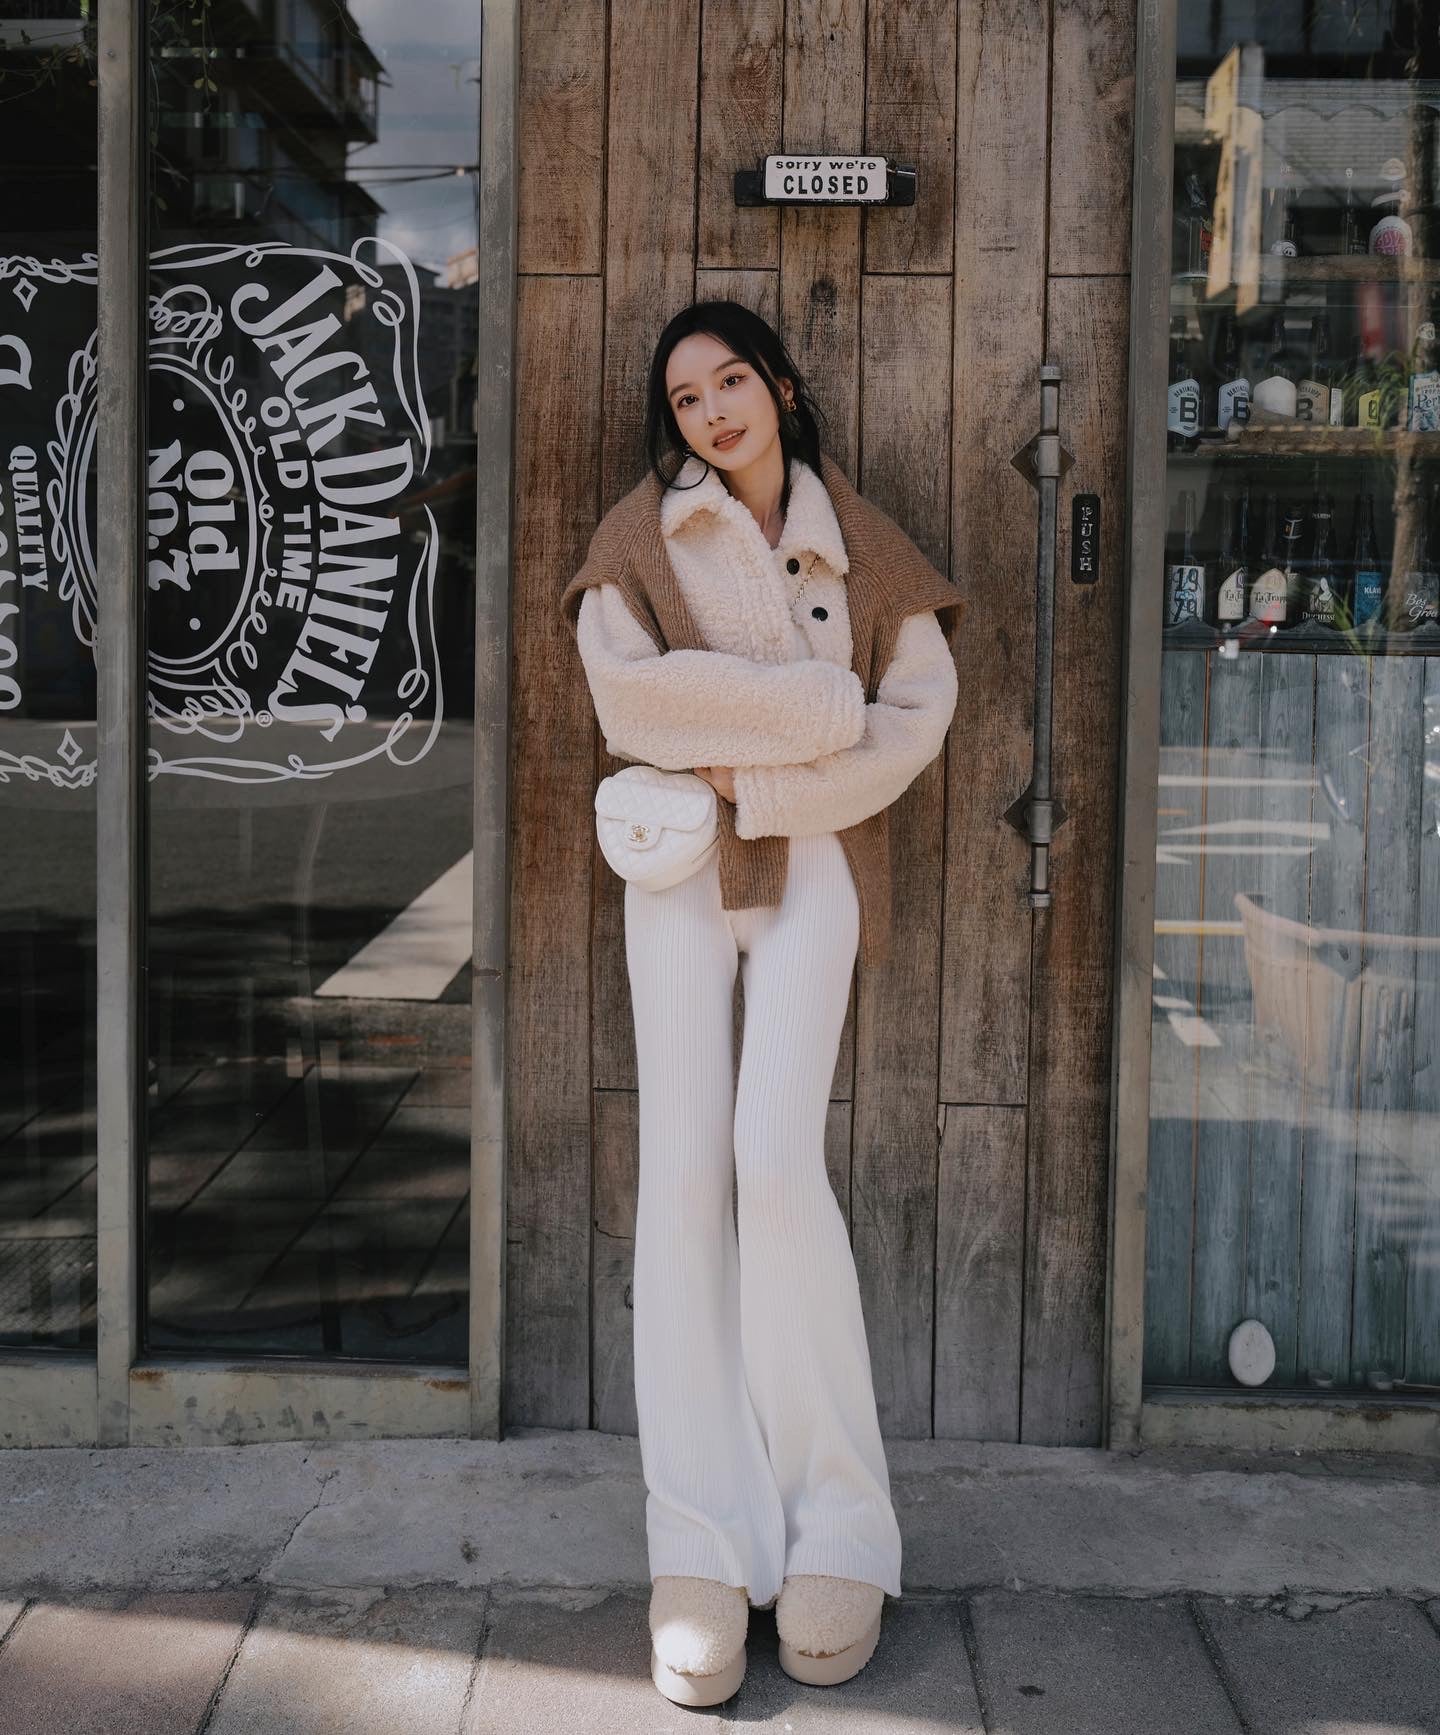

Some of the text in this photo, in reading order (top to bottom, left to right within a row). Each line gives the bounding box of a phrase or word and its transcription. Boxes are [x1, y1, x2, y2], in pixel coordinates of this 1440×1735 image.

[776, 160, 877, 171] sorry we're
[783, 175, 869, 195] CLOSED
[230, 264, 386, 457] JACK
[8, 444, 49, 592] QUALITY
[185, 449, 240, 576] Old
[260, 396, 313, 613] OLD TIME
[1079, 506, 1094, 571] PUSH
[268, 438, 414, 742] DANIEL'S
